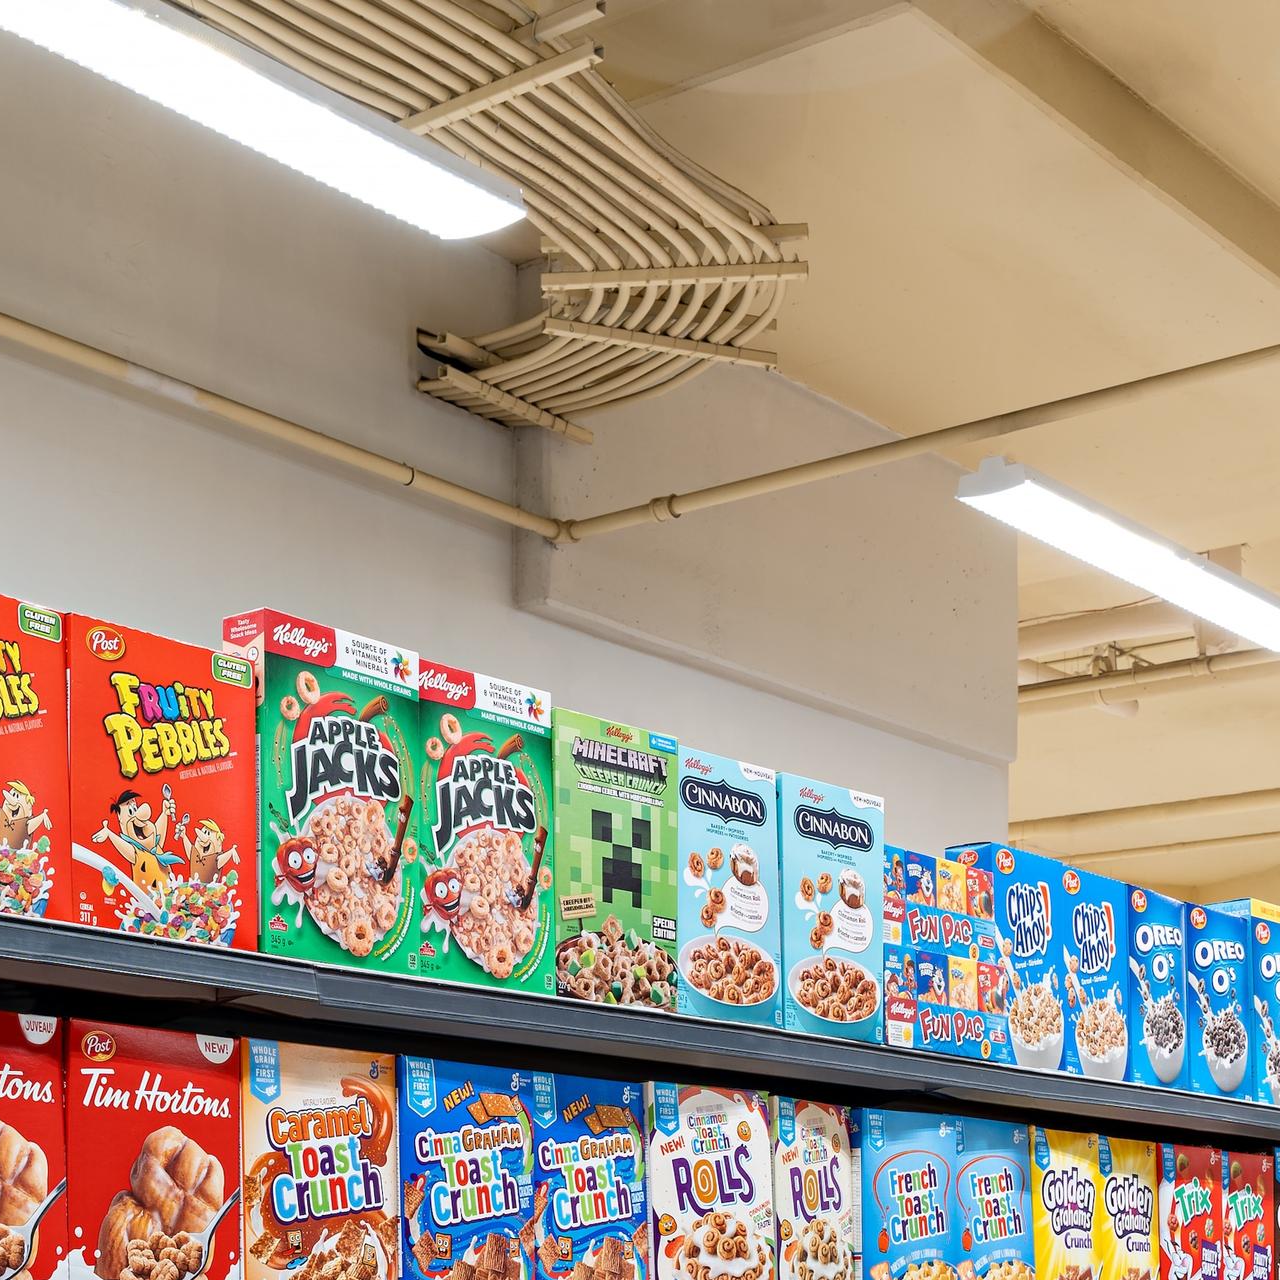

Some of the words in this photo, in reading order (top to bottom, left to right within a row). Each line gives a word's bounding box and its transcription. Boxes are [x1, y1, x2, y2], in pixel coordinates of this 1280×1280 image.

[273, 623, 331, 654] Kellogg's
[309, 720, 377, 747] APPLE
[570, 736, 668, 776] MINECRAFT
[289, 740, 400, 817] JACKS
[684, 787, 762, 820] CINNABON
[998, 852, 1013, 870] Post
[653, 917, 676, 930] SPECIAL
[653, 926, 676, 940] EDITION
[1136, 924, 1183, 954] OREO
[921, 1008, 952, 1043] FUN
[954, 1015, 984, 1043] PAC
[204, 1041, 229, 1056] NEW!
[270, 1106, 372, 1145] Caramel
[287, 1140, 360, 1180] Toast
[271, 1163, 383, 1223] Crunch
[672, 1146, 755, 1216] ROLLS
[890, 1162, 938, 1193] French
[1042, 1167, 1096, 1214] Golden
[897, 1190, 936, 1217] Toast
[1176, 1177, 1212, 1225] Trix
[892, 1209, 946, 1243] Crunch
[1051, 1204, 1094, 1236] Grahams
[1065, 1234, 1093, 1249] Crunch
